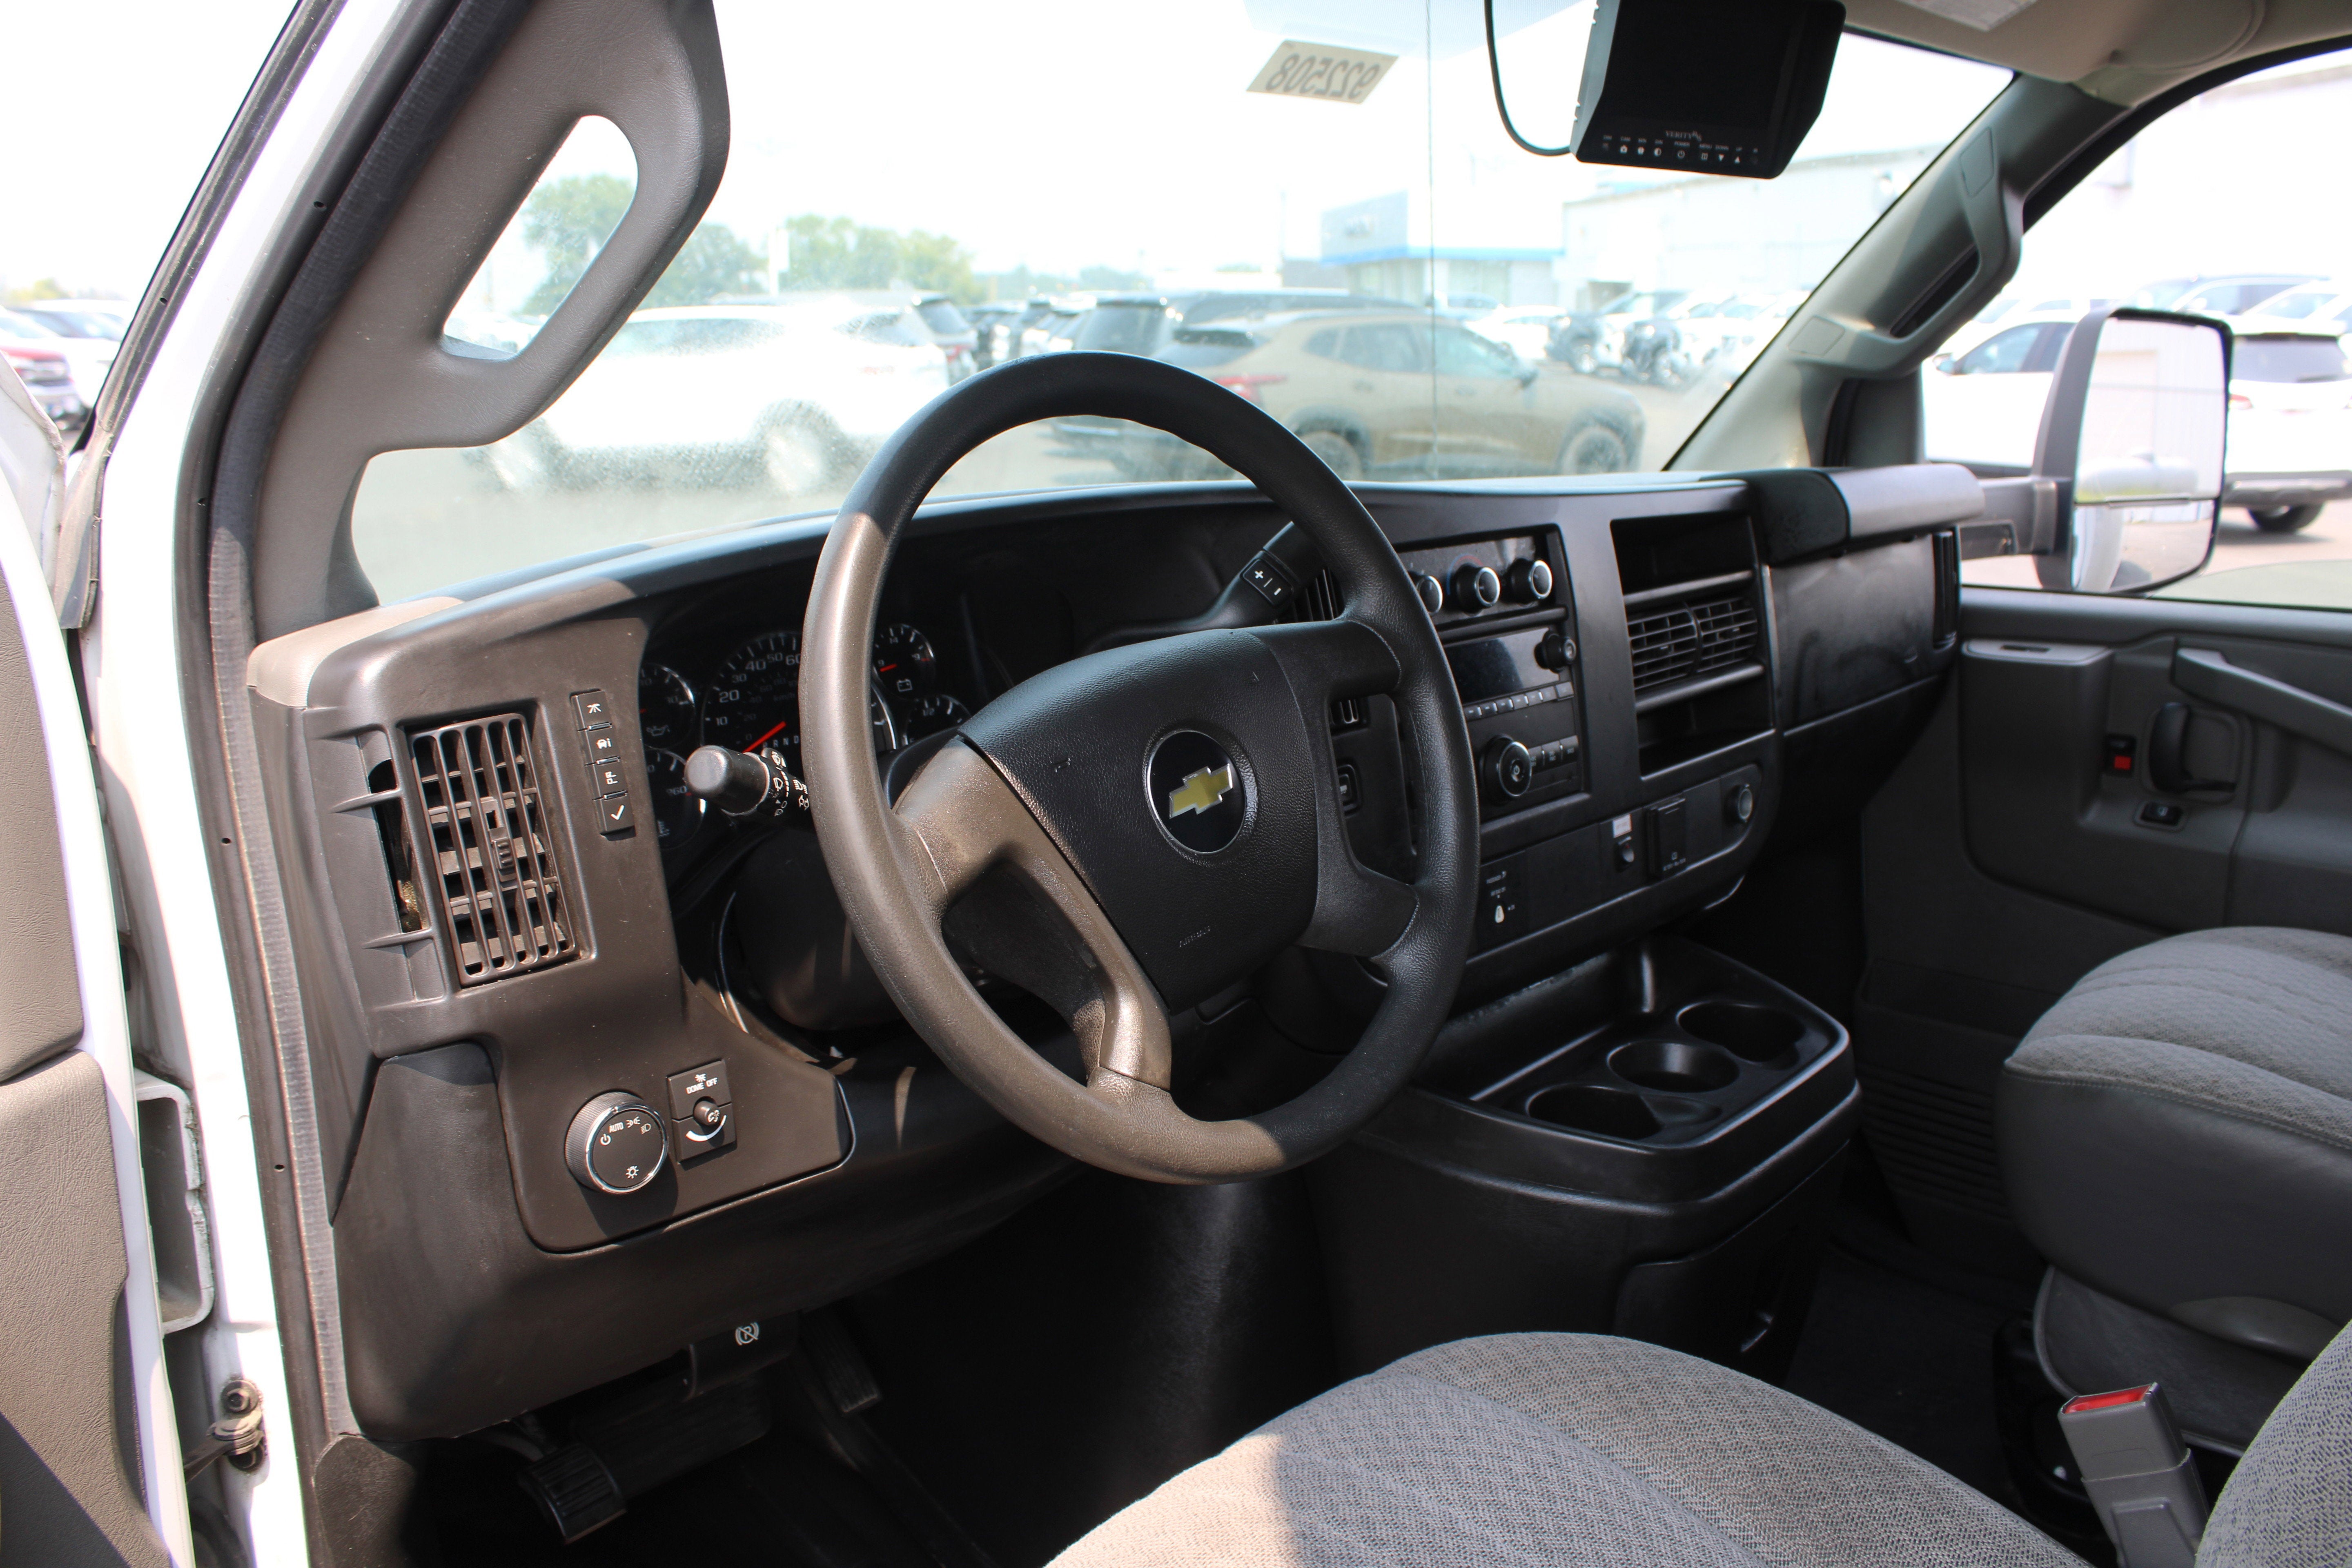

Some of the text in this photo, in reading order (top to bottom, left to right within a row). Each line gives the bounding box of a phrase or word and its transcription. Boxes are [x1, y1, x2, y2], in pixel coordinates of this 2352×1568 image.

[766, 652, 783, 663] 50
[745, 659, 766, 671] 40
[731, 673, 747, 683] 30
[718, 689, 740, 704] 20
[715, 716, 728, 726] 10
[783, 737, 789, 746] N
[686, 1077, 718, 1094] DOME OFF
[609, 1122, 624, 1133] AUTO
